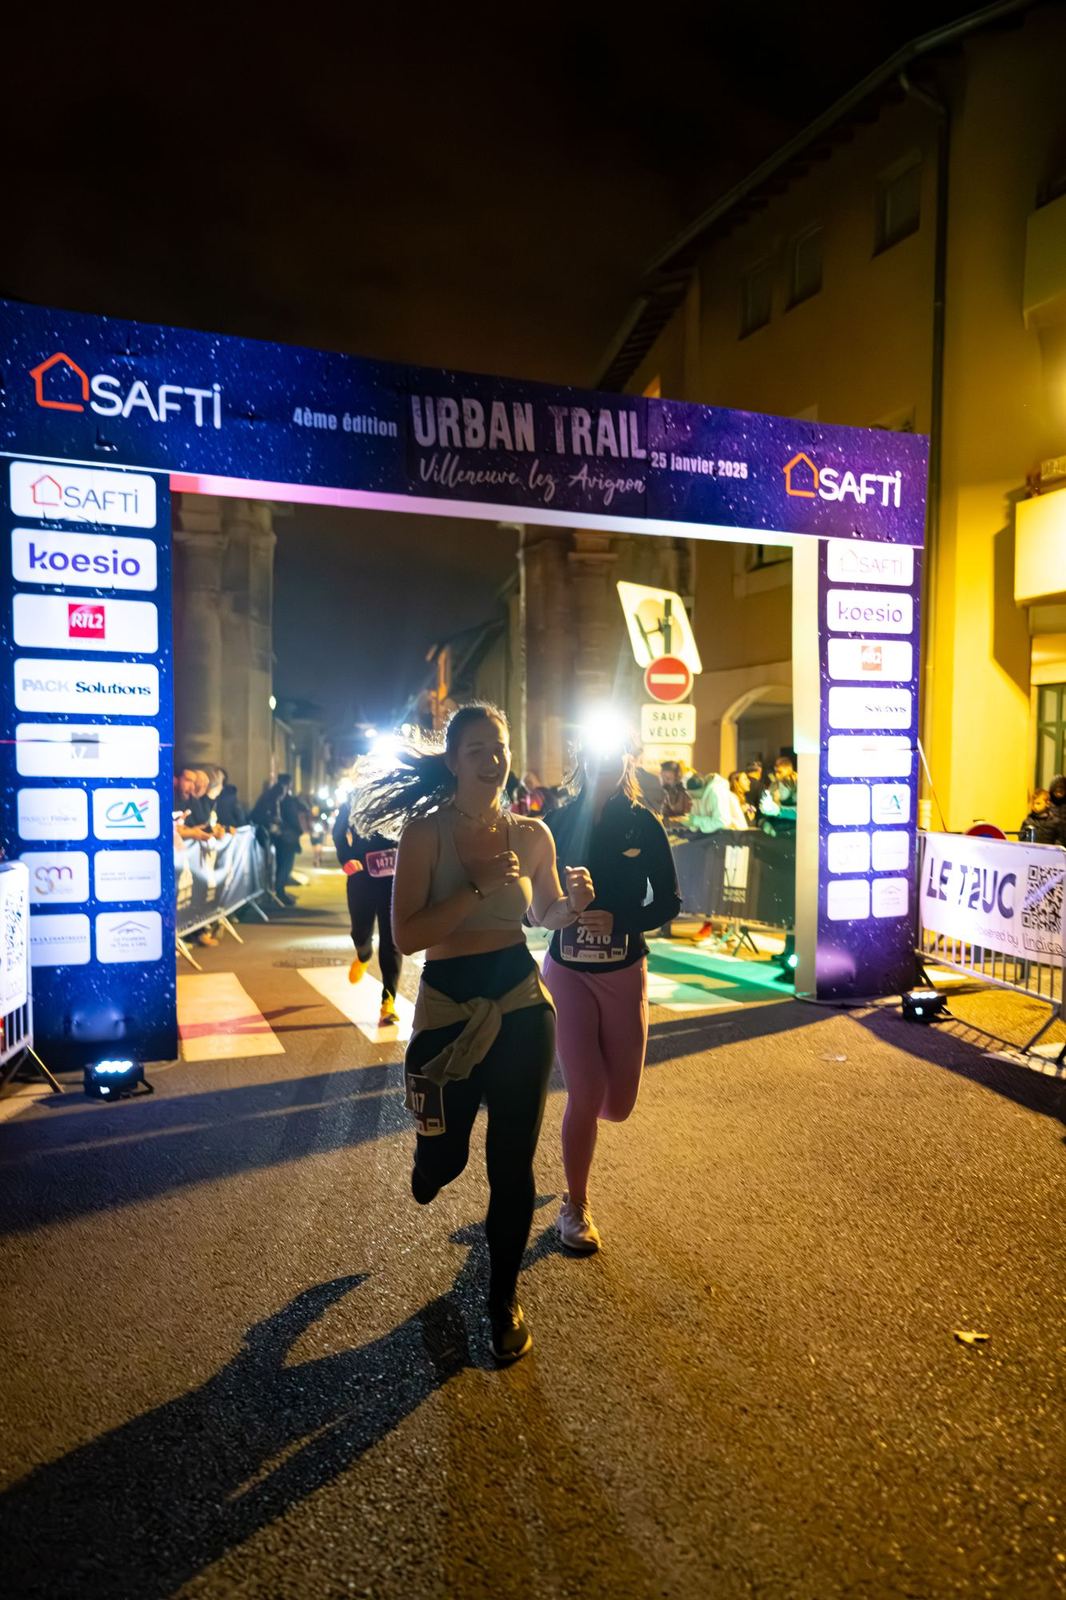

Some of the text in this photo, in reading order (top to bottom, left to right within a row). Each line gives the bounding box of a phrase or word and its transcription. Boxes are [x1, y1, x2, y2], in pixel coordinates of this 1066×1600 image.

[293, 406, 398, 438] 4ème édition
[411, 395, 648, 460] URBAN TRAIL
[420, 452, 646, 506] Villeneuve lez Avignon
[650, 451, 667, 468] 25
[717, 458, 748, 479] 2025
[28, 541, 141, 577] koesio
[71, 612, 104, 629] RTL2
[838, 600, 902, 623] koesio
[22, 678, 151, 695] PACK Solutions
[652, 711, 684, 721] SAUF
[926, 857, 952, 901] LE
